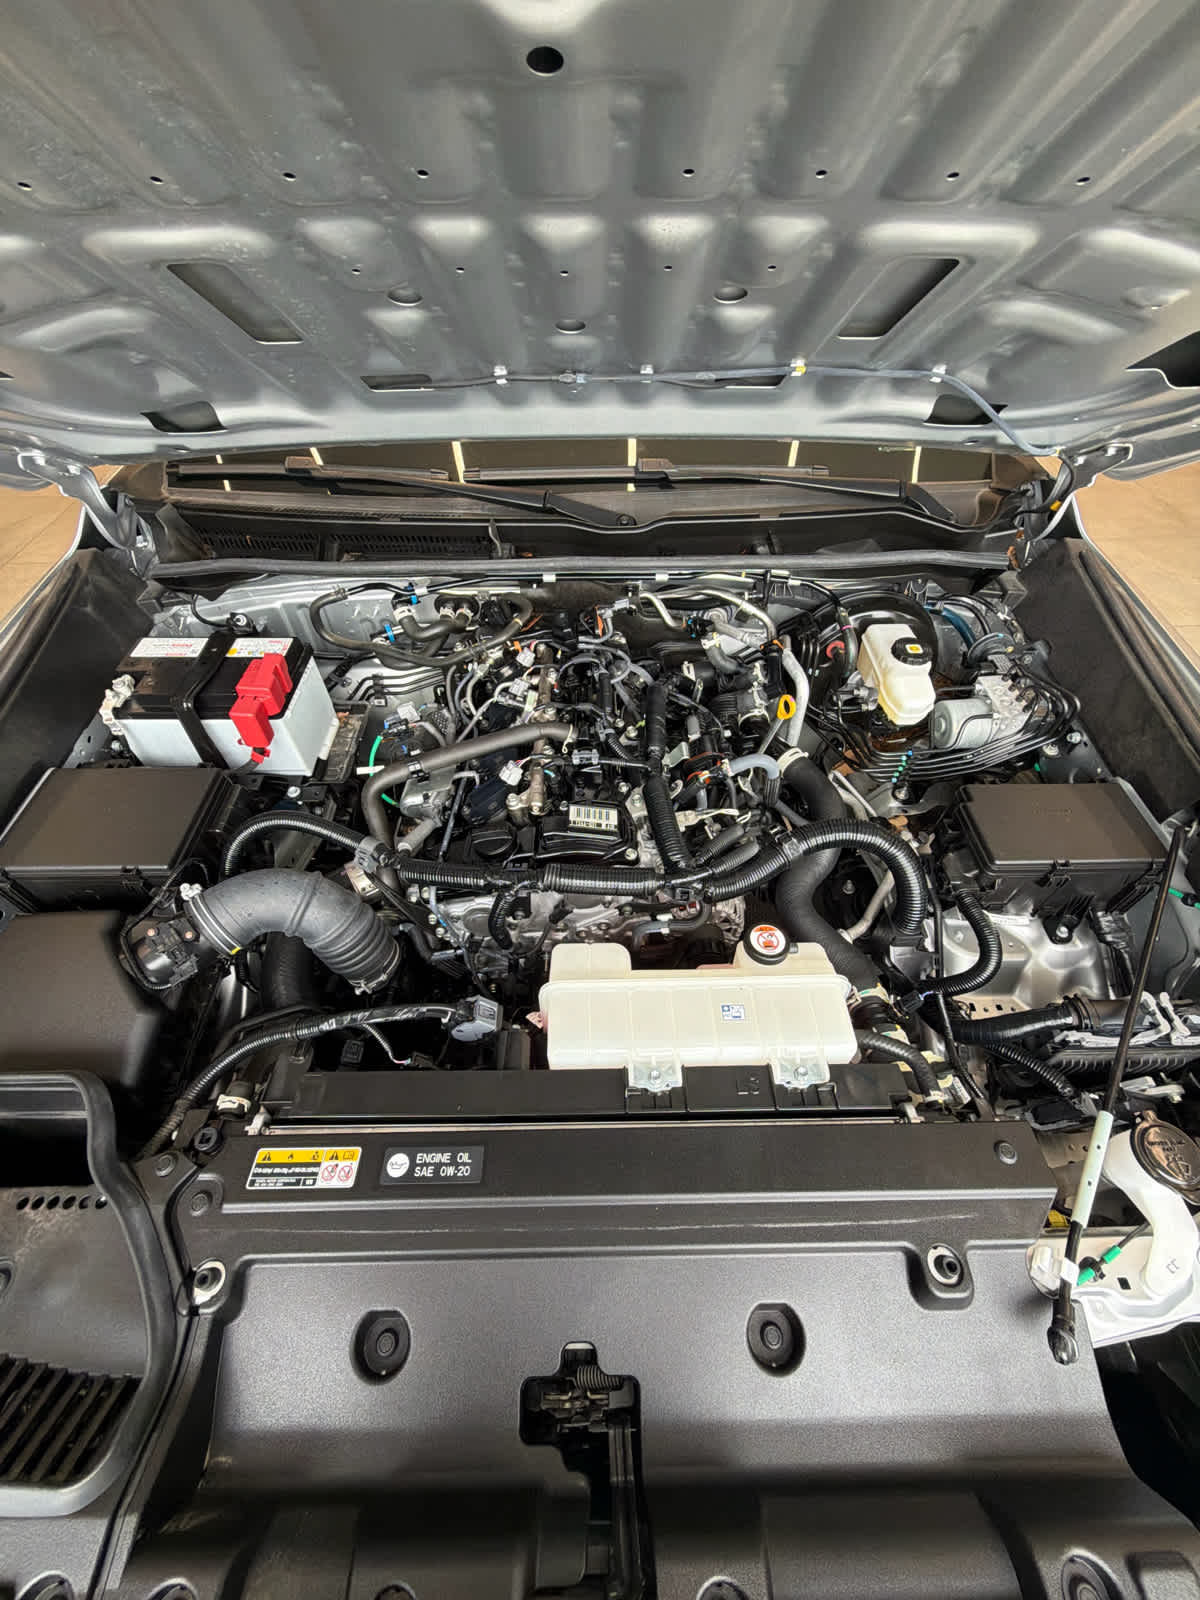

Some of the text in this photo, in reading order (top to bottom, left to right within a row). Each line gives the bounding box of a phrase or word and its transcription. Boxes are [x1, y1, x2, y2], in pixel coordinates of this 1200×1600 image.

[416, 1152, 472, 1163] ENGINE OIL
[414, 1165, 471, 1177] SAE 0W-20
